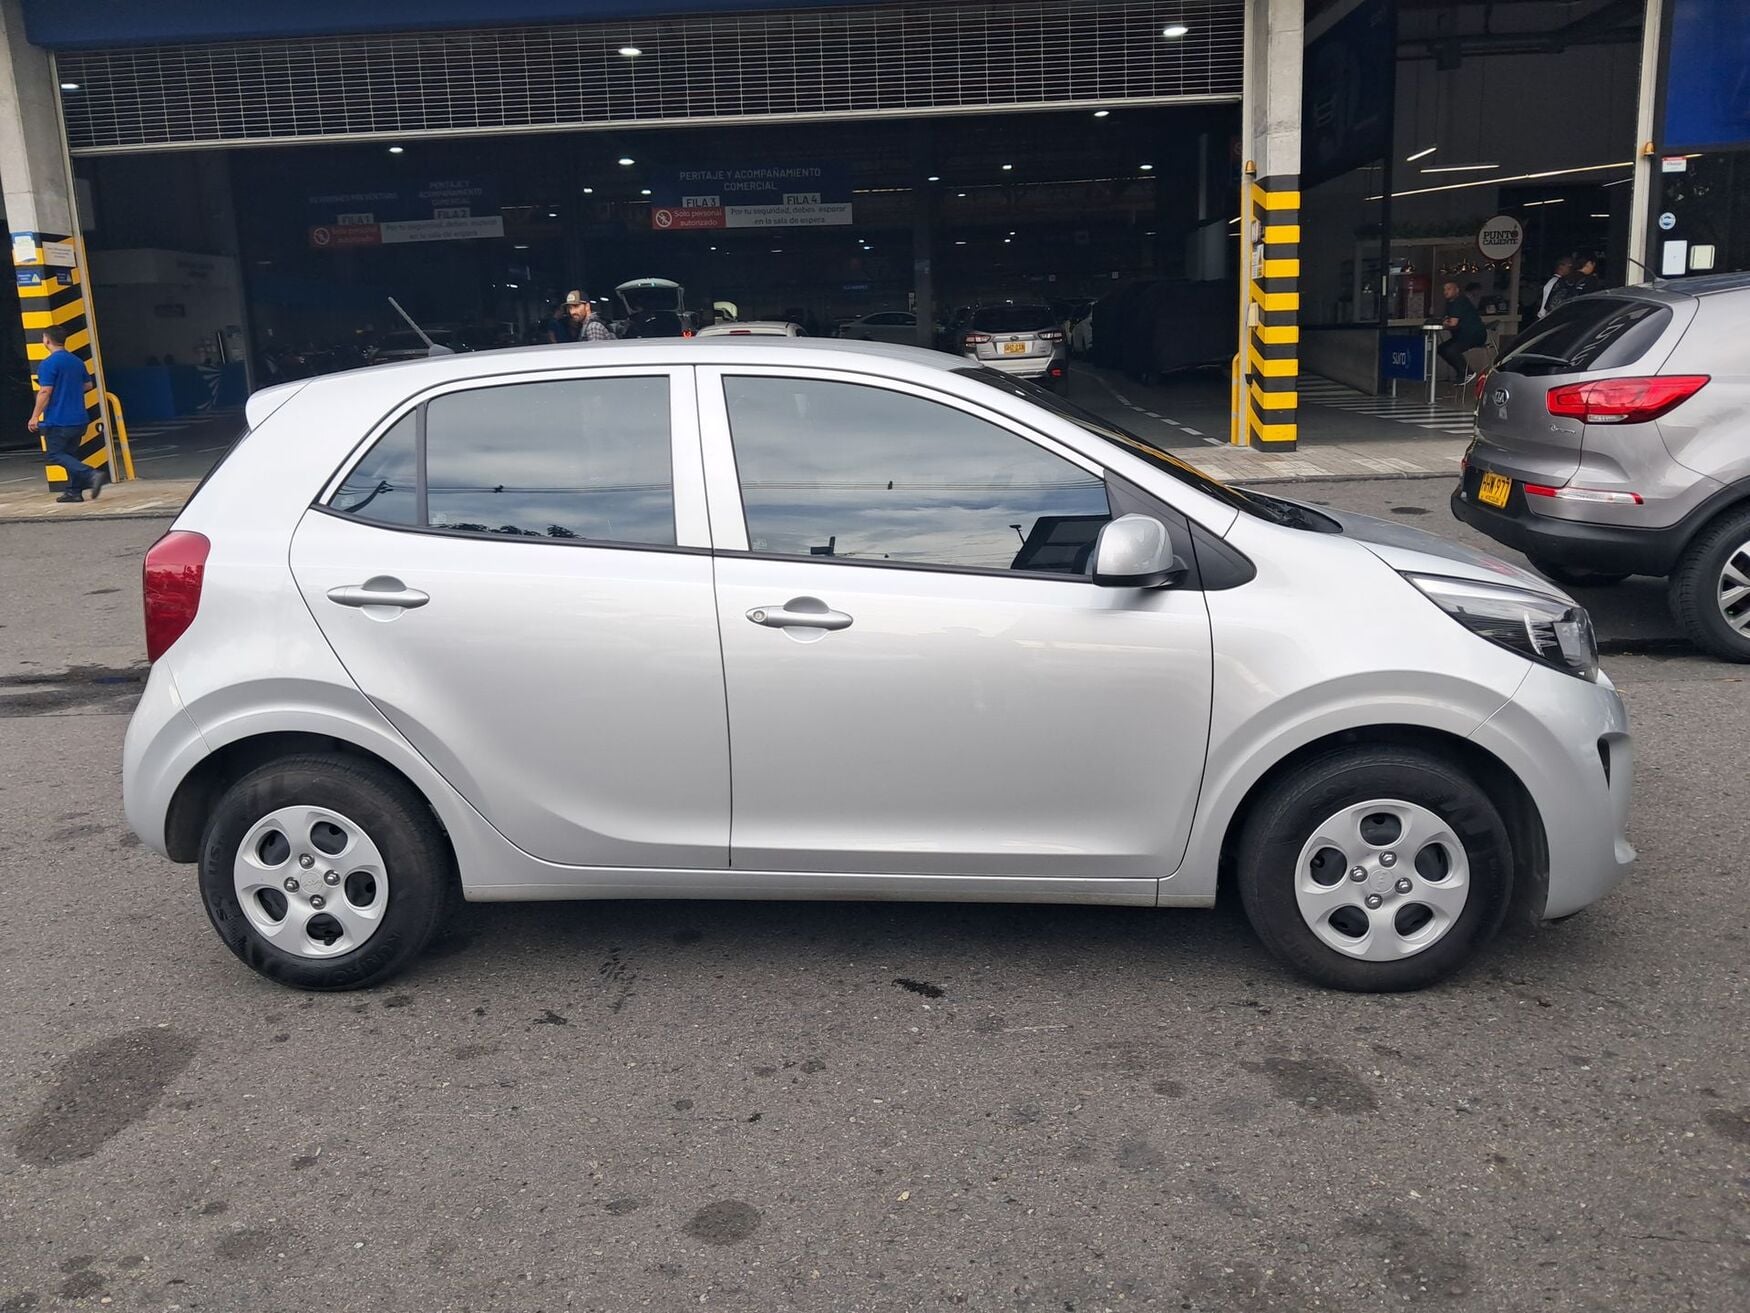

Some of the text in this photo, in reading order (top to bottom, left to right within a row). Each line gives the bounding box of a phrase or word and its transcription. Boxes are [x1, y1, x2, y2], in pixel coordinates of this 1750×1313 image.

[679, 167, 821, 181] PERITAJE Y ACOMPAÑAMIENTO
[723, 182, 777, 191] COMERCIAL
[686, 197, 716, 207] FILA 3
[786, 195, 817, 205] FILA 4
[1483, 229, 1519, 239] PUNTO
[1482, 238, 1519, 246] CALIENTE
